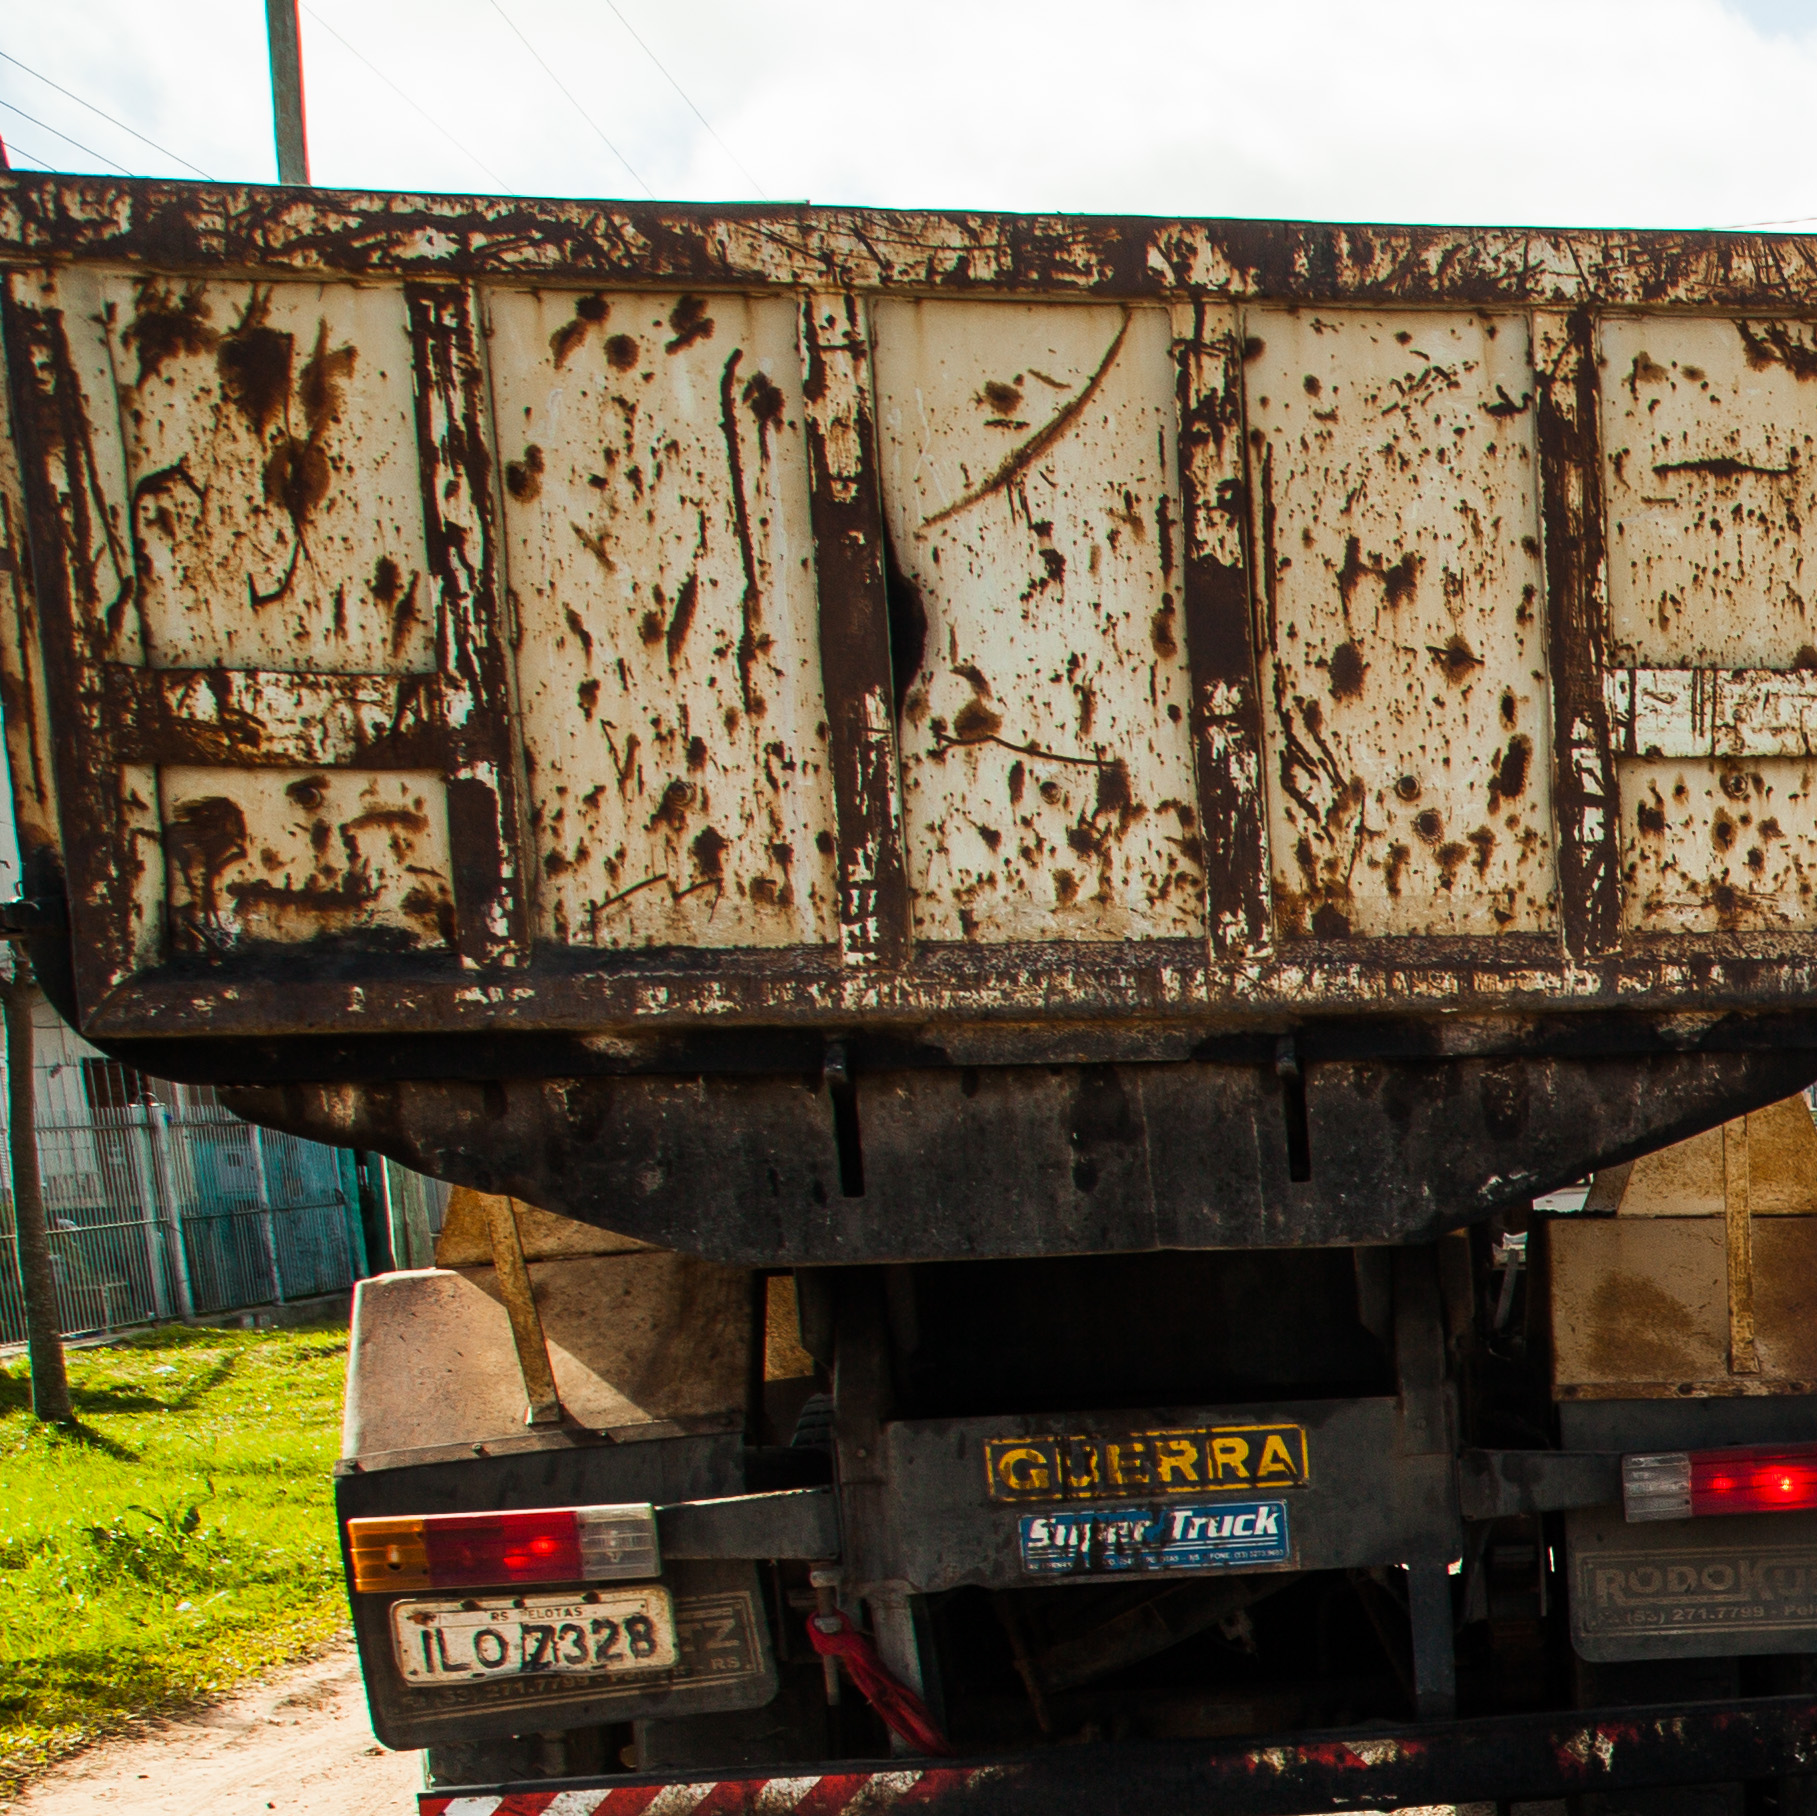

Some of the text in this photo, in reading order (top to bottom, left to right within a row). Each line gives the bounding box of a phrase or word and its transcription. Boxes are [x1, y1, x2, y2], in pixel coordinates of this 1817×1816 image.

[999, 1434, 1297, 1490] GUERRA
[1171, 1506, 1281, 1541] Truck
[491, 1610, 510, 1622] RS
[1673, 1605, 1765, 1622] 271.7799
[711, 1654, 740, 1671] RS
